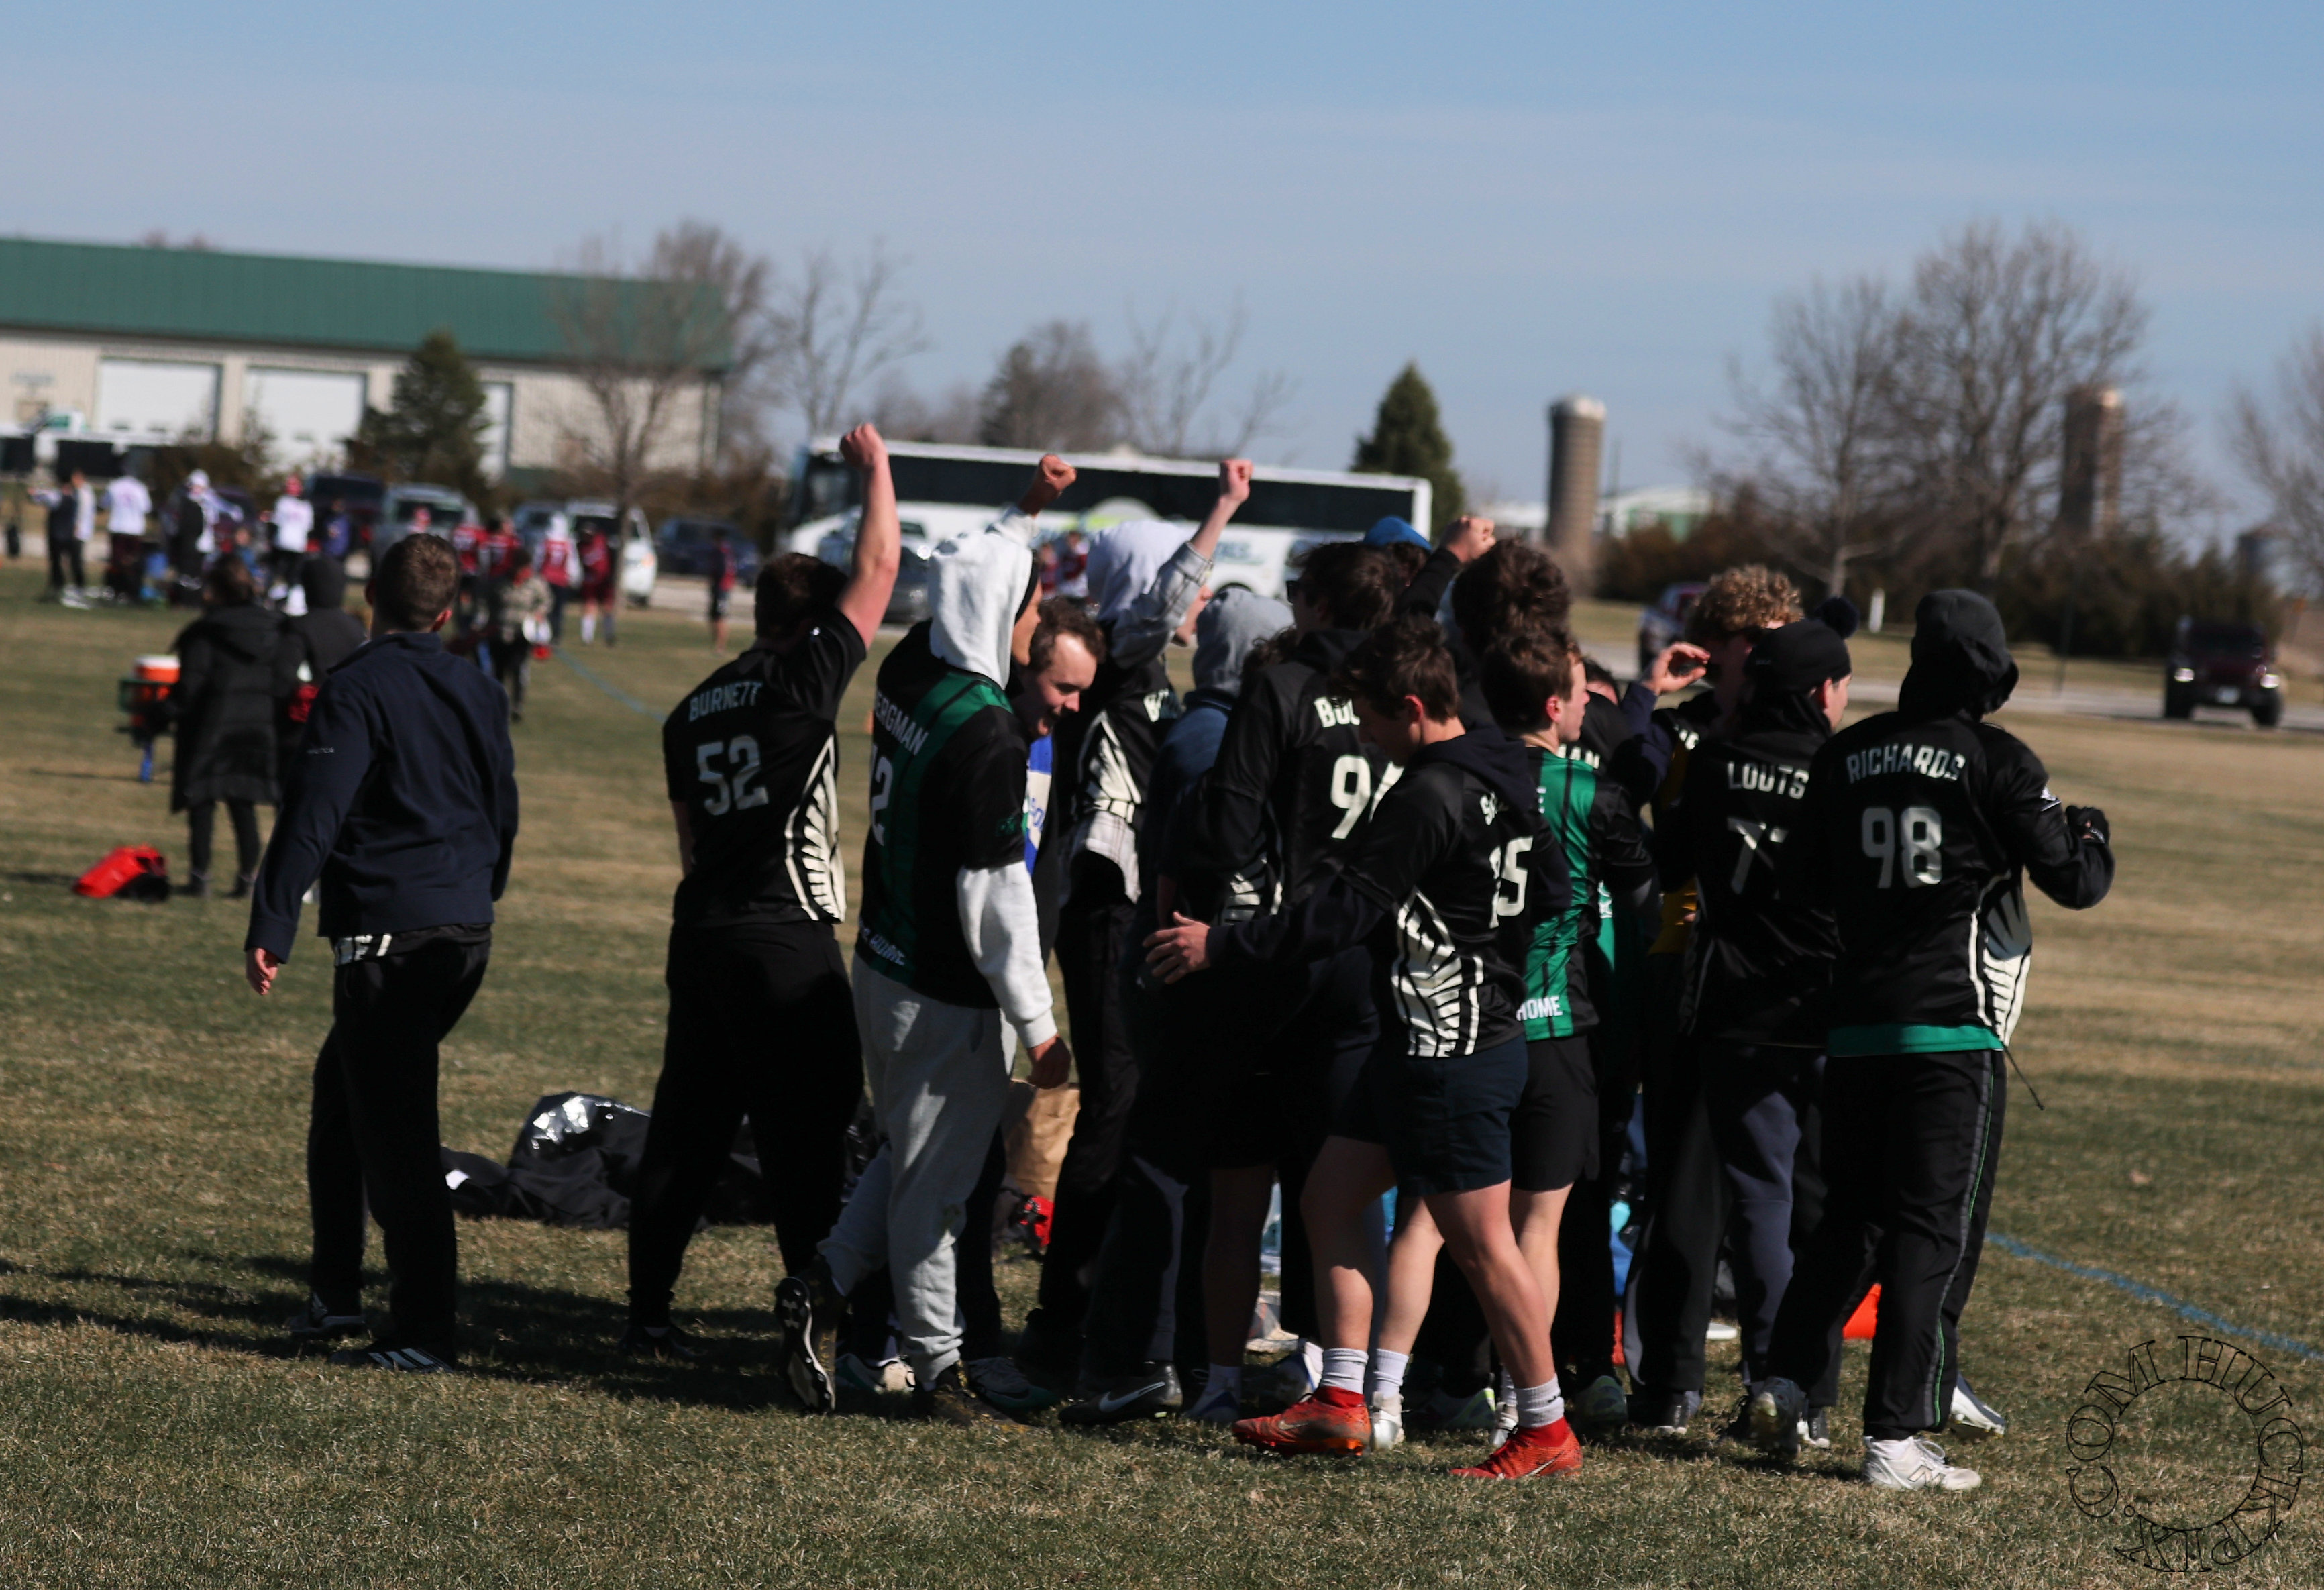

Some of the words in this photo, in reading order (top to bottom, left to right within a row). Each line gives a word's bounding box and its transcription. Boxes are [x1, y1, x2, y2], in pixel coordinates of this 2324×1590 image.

[688, 680, 763, 722] BURNETT
[696, 734, 769, 816] 52
[1846, 743, 1966, 784] RICHARDS
[1861, 806, 1942, 888] 98
